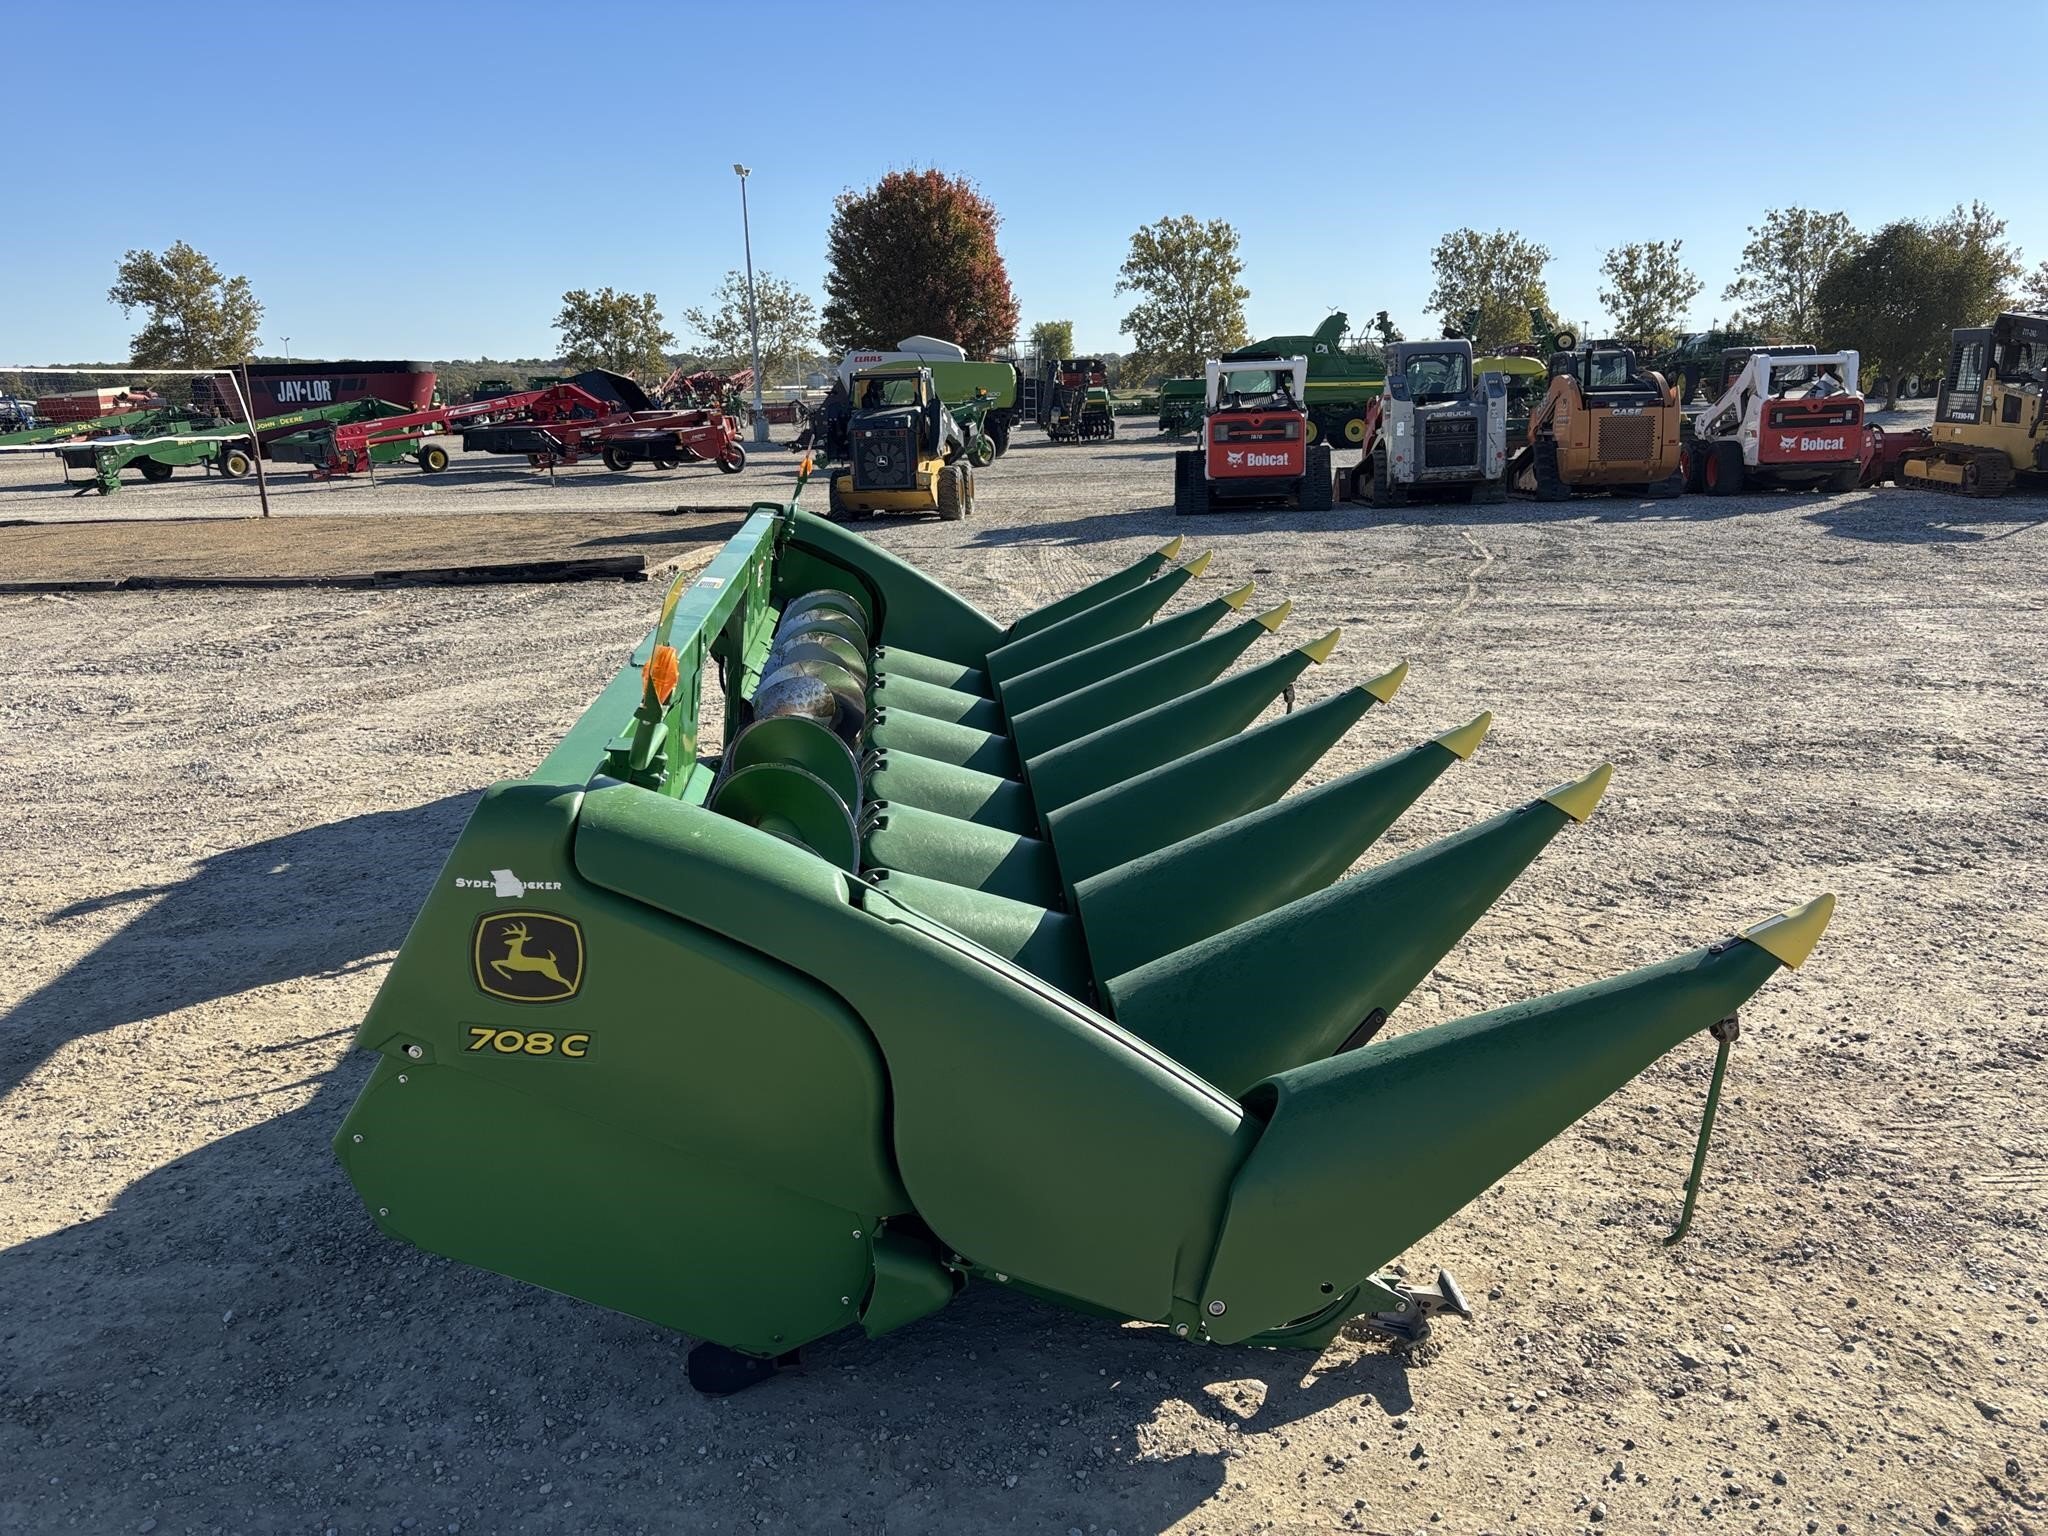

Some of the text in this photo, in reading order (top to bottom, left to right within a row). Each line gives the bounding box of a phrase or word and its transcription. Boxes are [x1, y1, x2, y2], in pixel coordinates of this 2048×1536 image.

[854, 355, 882, 363] CLAAS
[1612, 408, 1643, 416] CASE
[256, 416, 304, 430] JOHN DEERE
[54, 426, 74, 436] JOHN
[1800, 437, 1844, 451] Bobcat
[1247, 452, 1289, 466] Bobcat
[469, 1028, 590, 1057] 708 C
